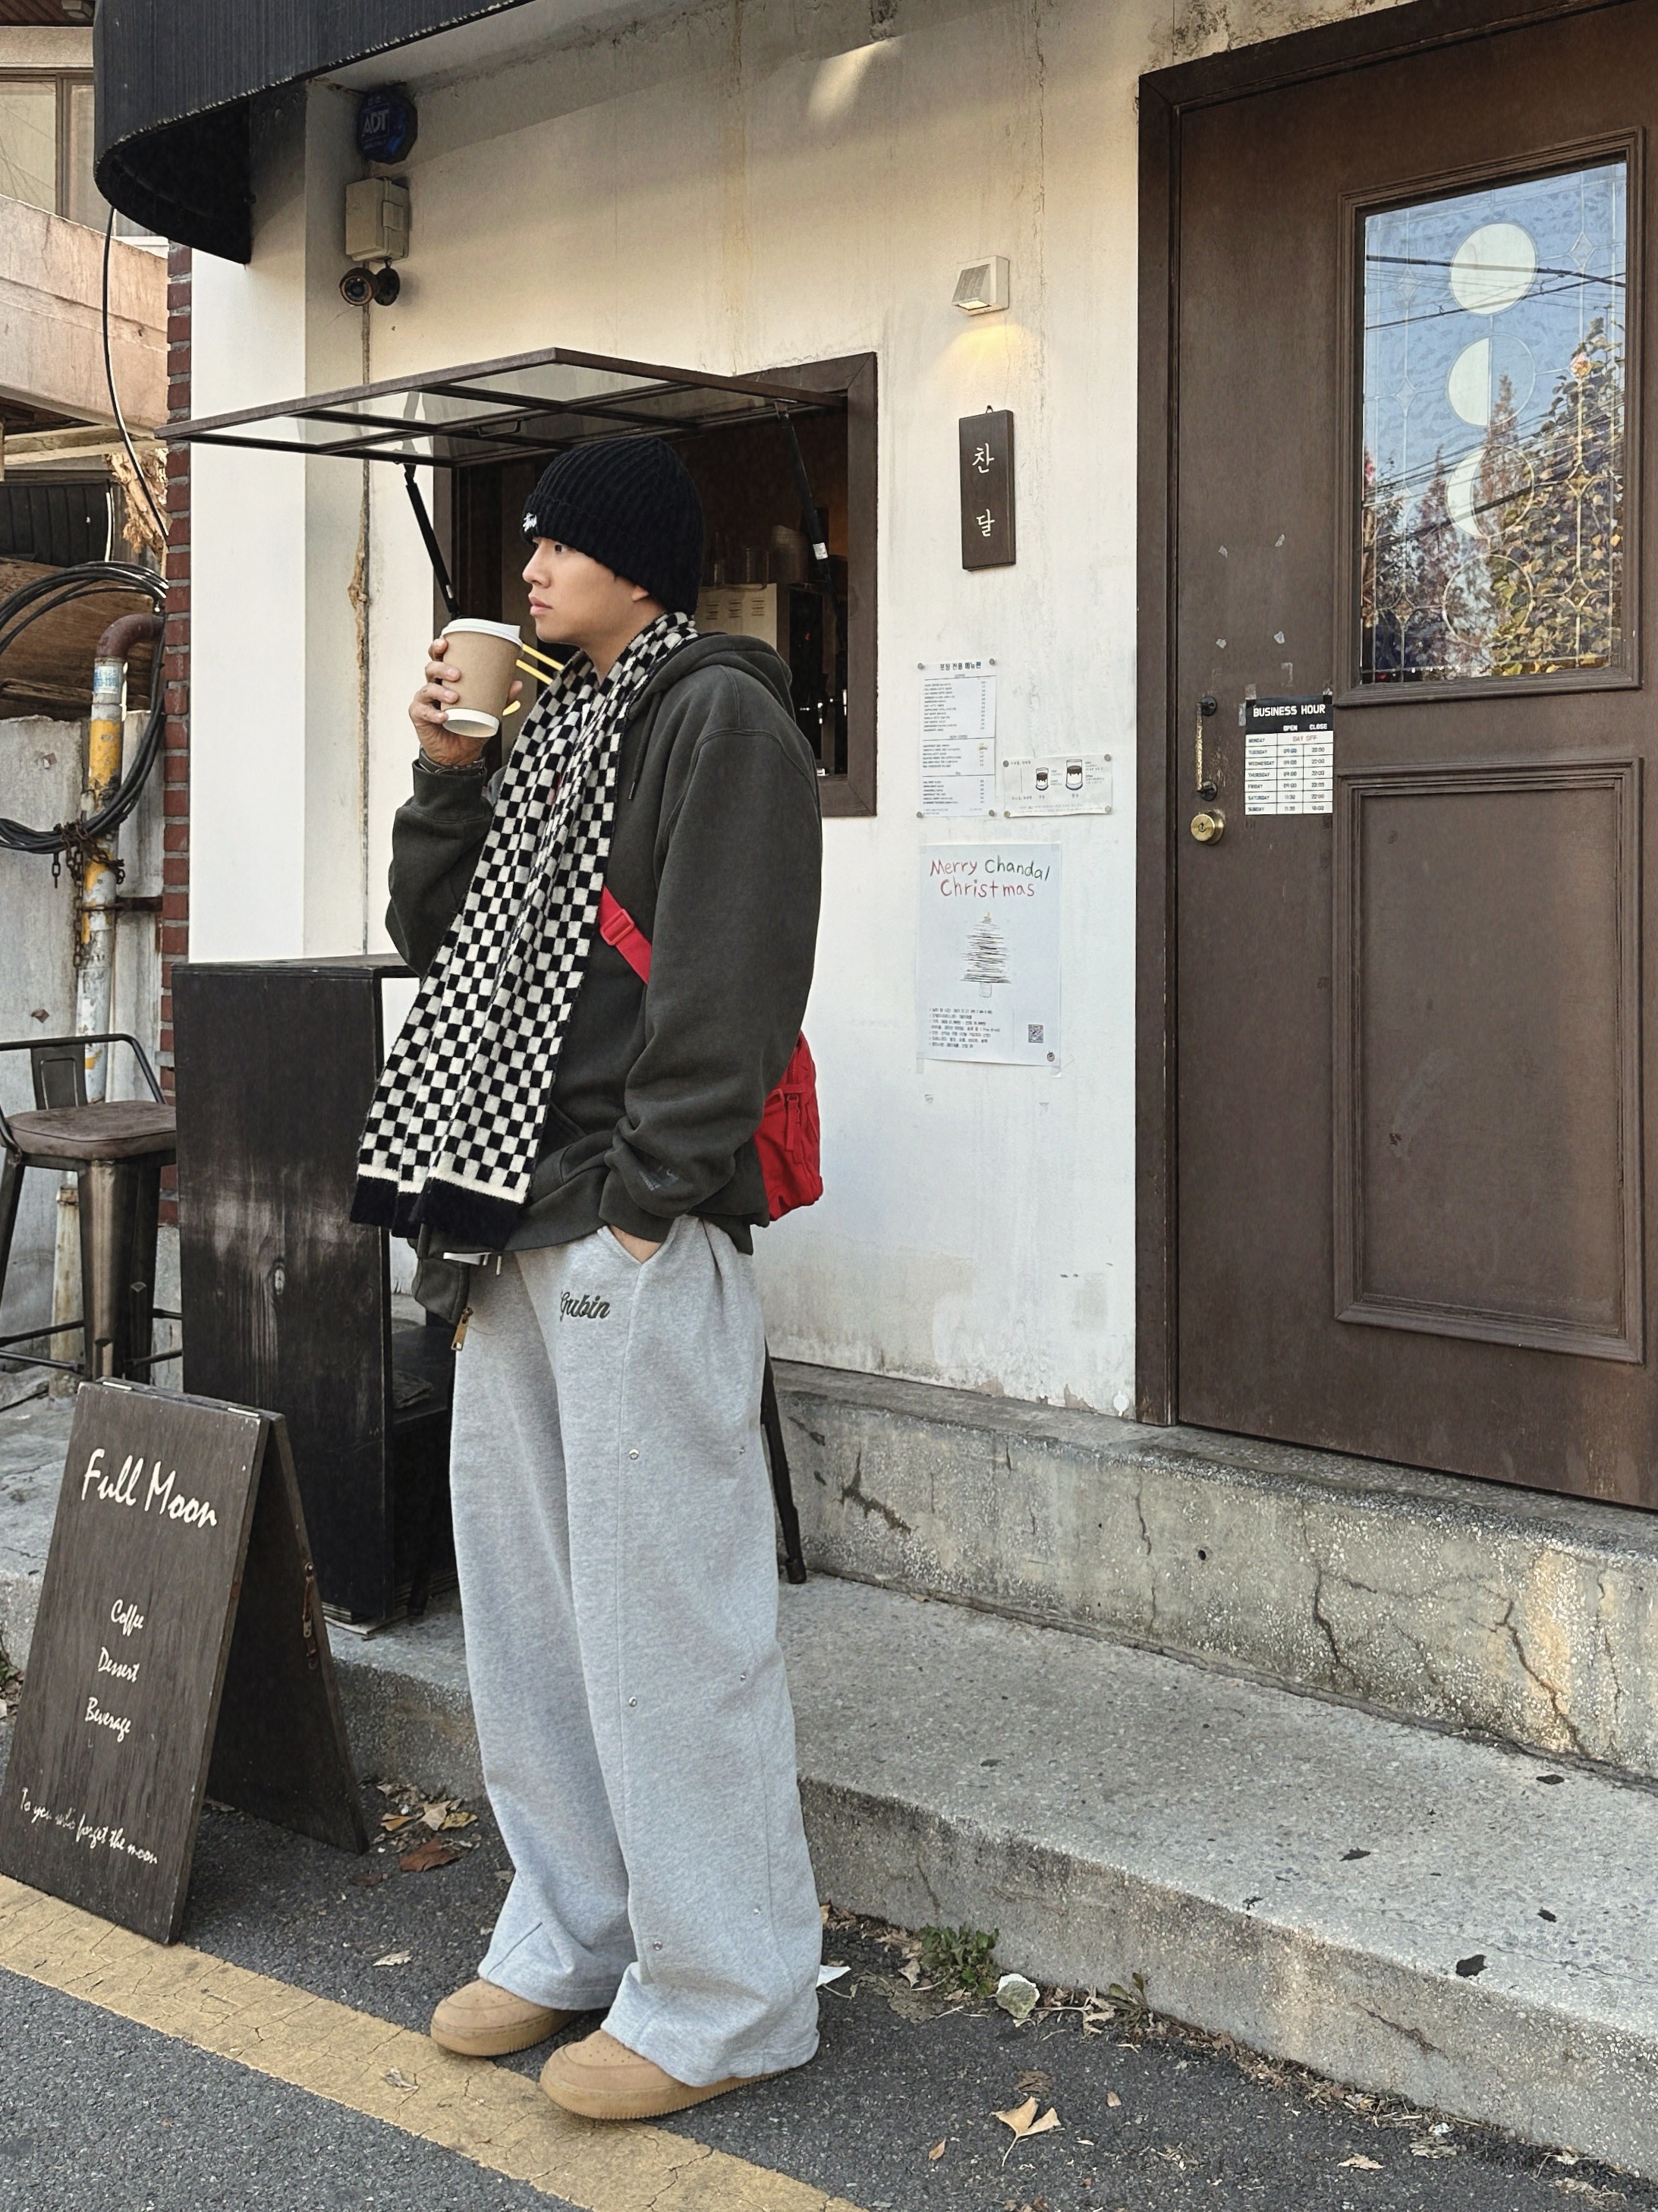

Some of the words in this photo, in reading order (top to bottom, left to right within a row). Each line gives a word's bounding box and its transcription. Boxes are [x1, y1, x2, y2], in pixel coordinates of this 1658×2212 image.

[361, 109, 389, 137] ADT
[1253, 706, 1298, 718] BUSINESS
[1301, 704, 1326, 715] HOUR
[930, 858, 978, 877] Merry
[984, 855, 1050, 882] Chandal
[939, 875, 1035, 898] Christmas
[81, 1448, 144, 1506] Full
[144, 1460, 218, 1528] Moon
[111, 1599, 145, 1637] Coffee
[98, 1646, 140, 1683] Dessert
[85, 1696, 132, 1742] Beverage
[20, 1787, 31, 1812] To
[75, 1813, 109, 1849] forget
[109, 1827, 126, 1851] the
[127, 1843, 158, 1865] moon
